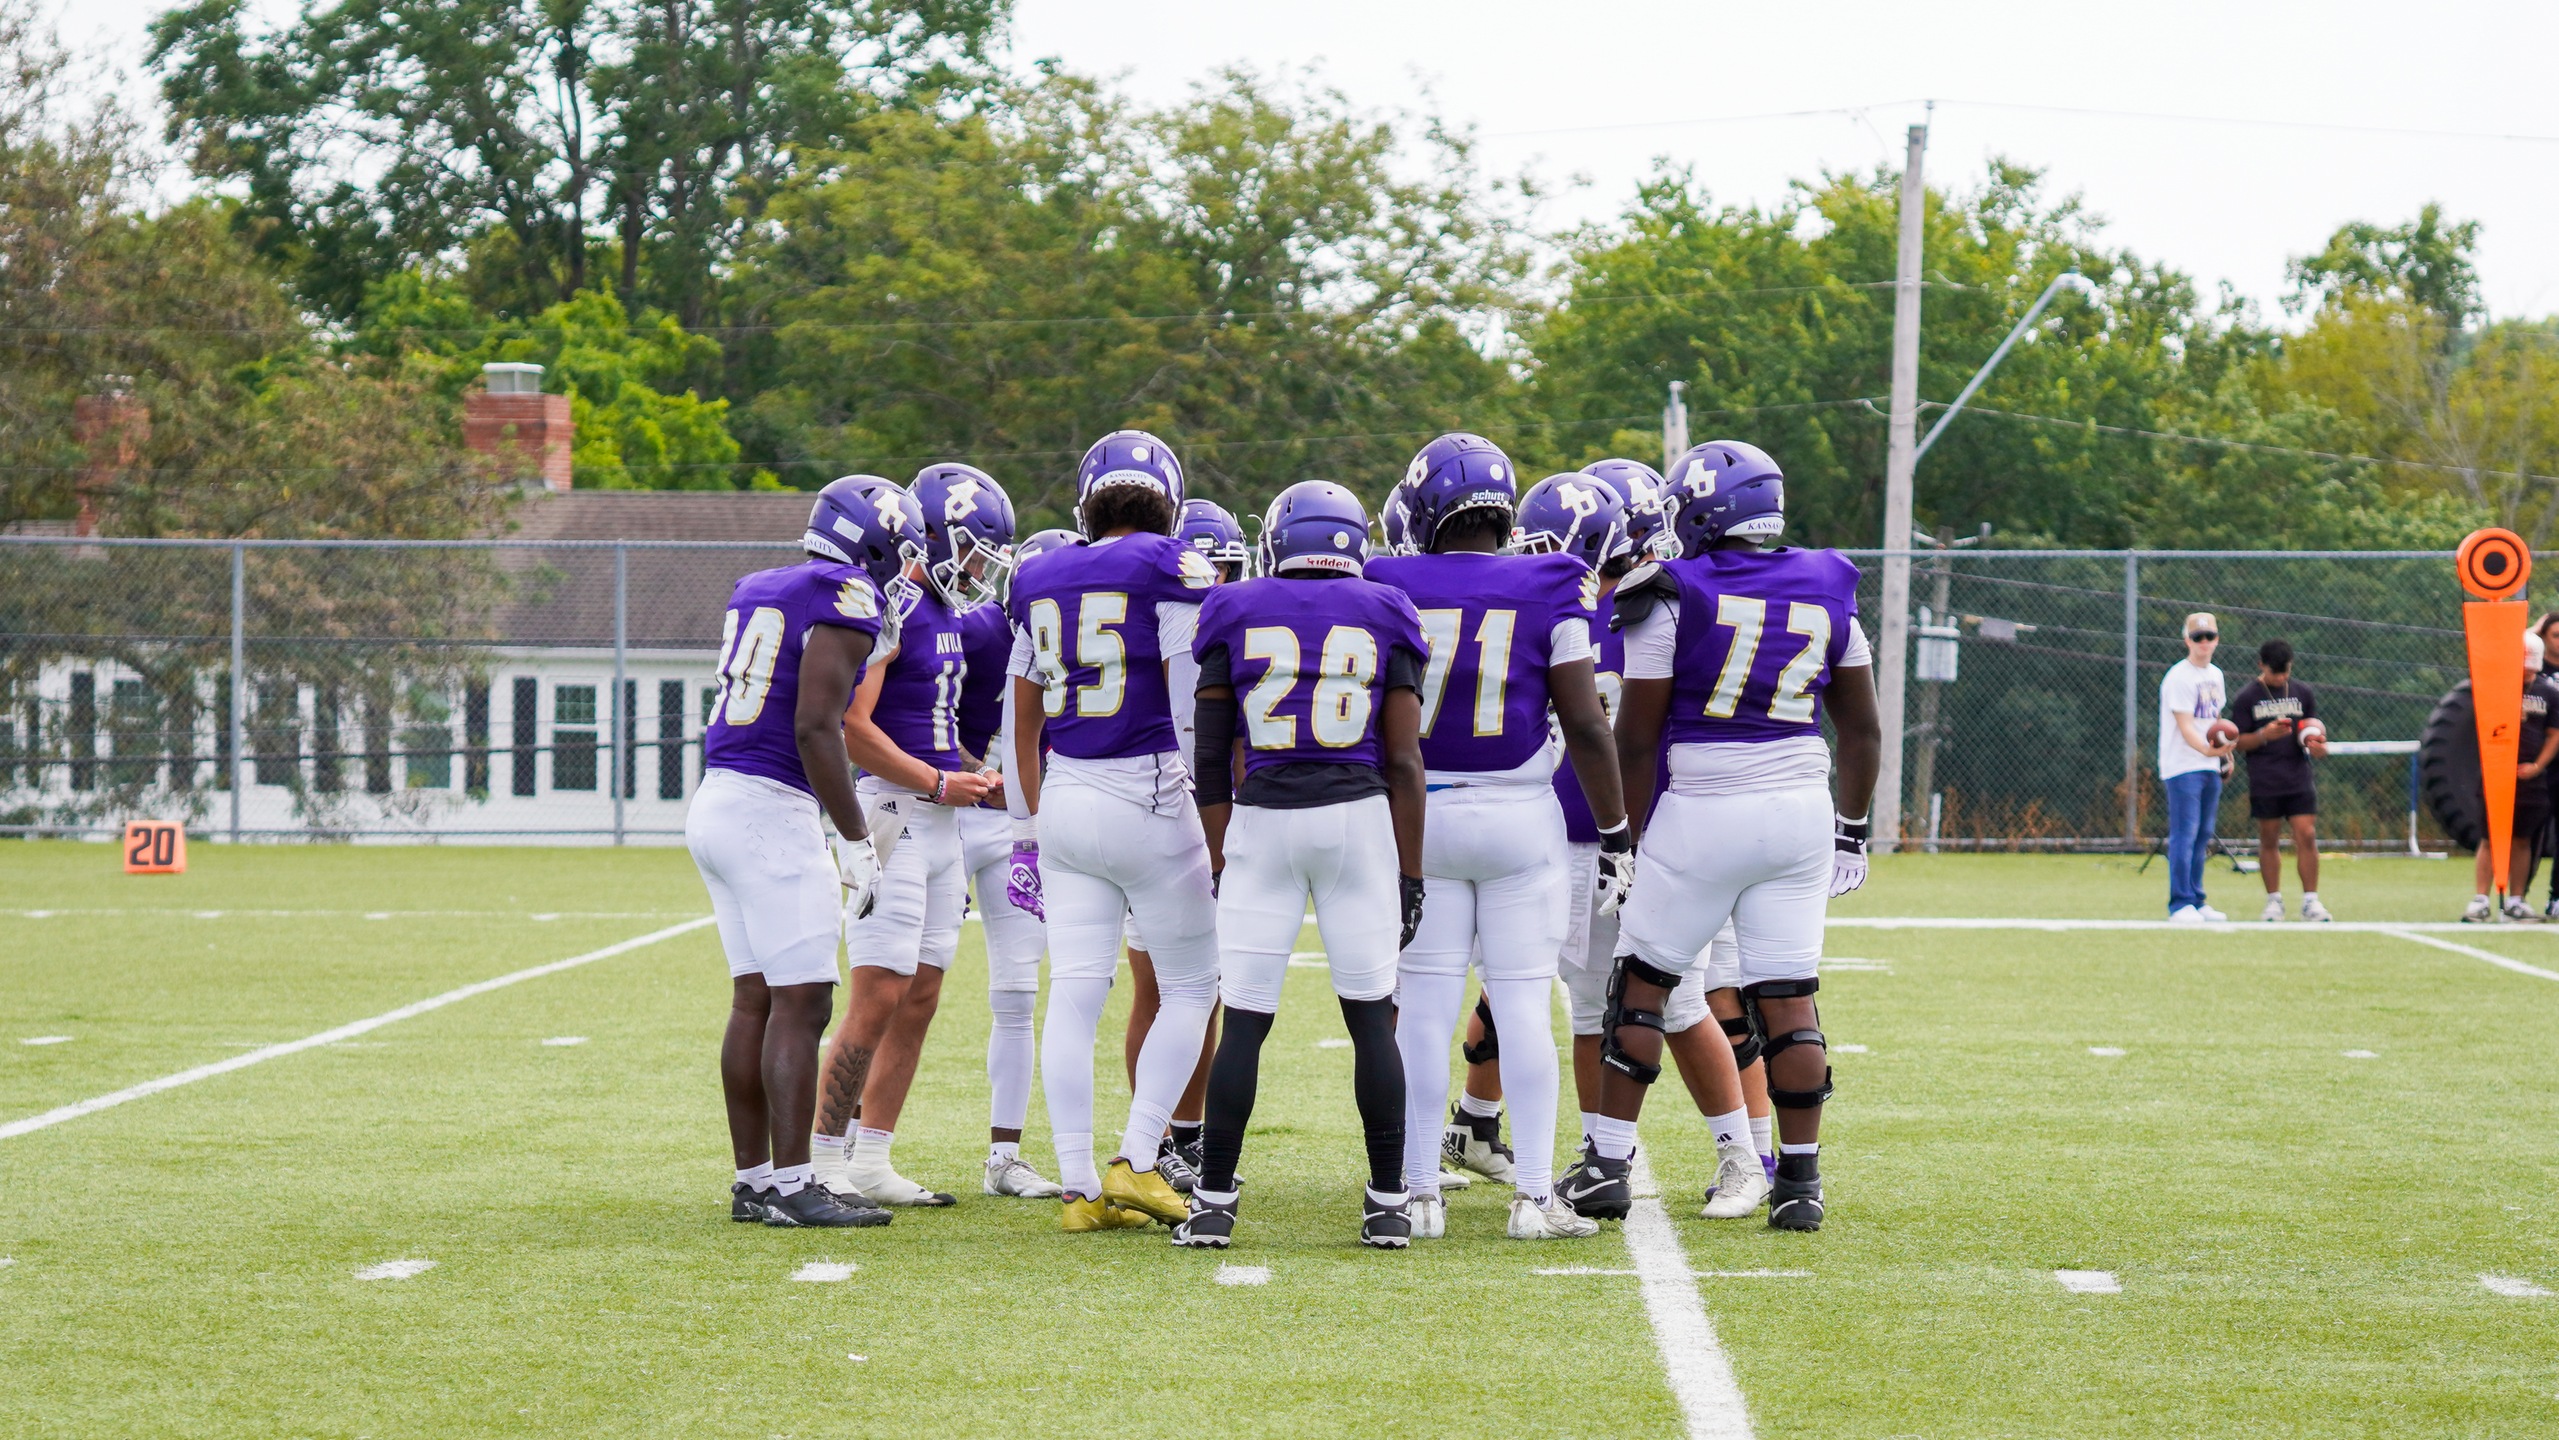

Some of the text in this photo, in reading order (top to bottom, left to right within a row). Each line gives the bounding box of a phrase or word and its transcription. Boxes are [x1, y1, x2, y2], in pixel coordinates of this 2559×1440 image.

[1471, 489, 1505, 502] schutt
[813, 540, 834, 555] CITY
[936, 632, 963, 655] AVILA
[1030, 591, 1129, 718] 85
[1702, 594, 1832, 724] 72
[1243, 625, 1378, 750] 28
[1418, 608, 1517, 739] 71
[931, 660, 968, 751] 11
[879, 804, 899, 816] adidas
[130, 827, 175, 866] 20
[1440, 1137, 1468, 1166] didas
